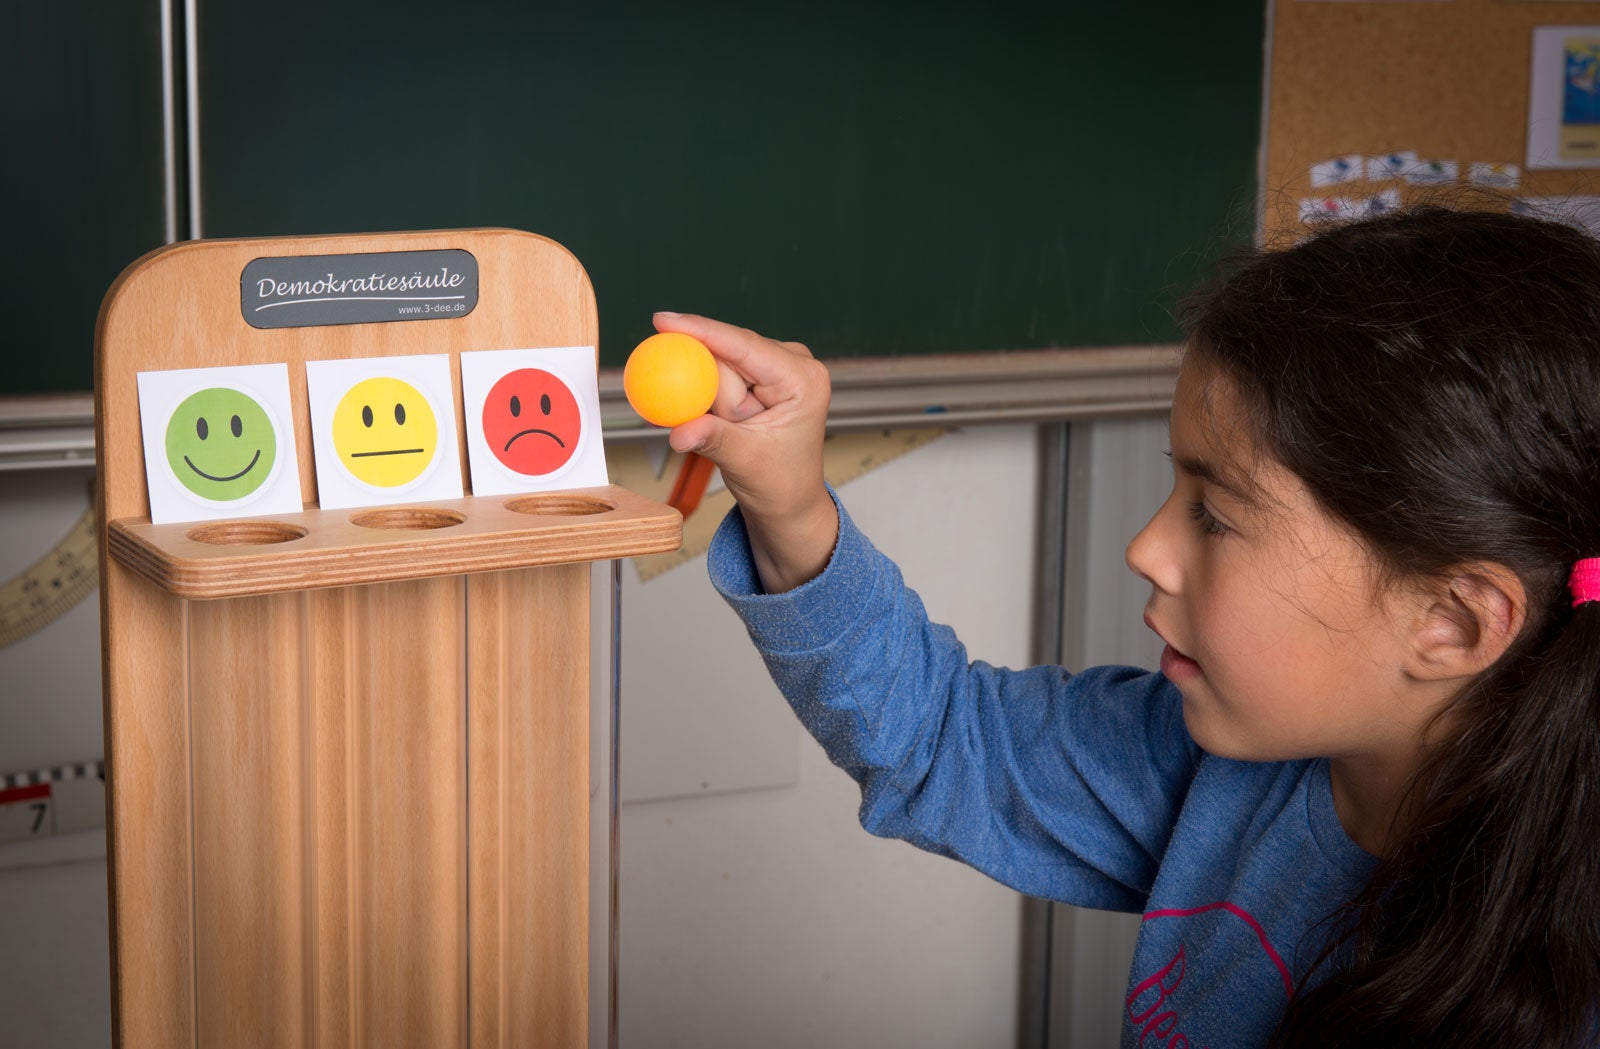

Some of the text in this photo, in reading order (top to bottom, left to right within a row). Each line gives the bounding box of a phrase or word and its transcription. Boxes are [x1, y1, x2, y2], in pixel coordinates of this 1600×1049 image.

[256, 267, 466, 298] Demokratiesäule
[398, 302, 466, 315] www.3-dee.de
[29, 803, 46, 834] 7
